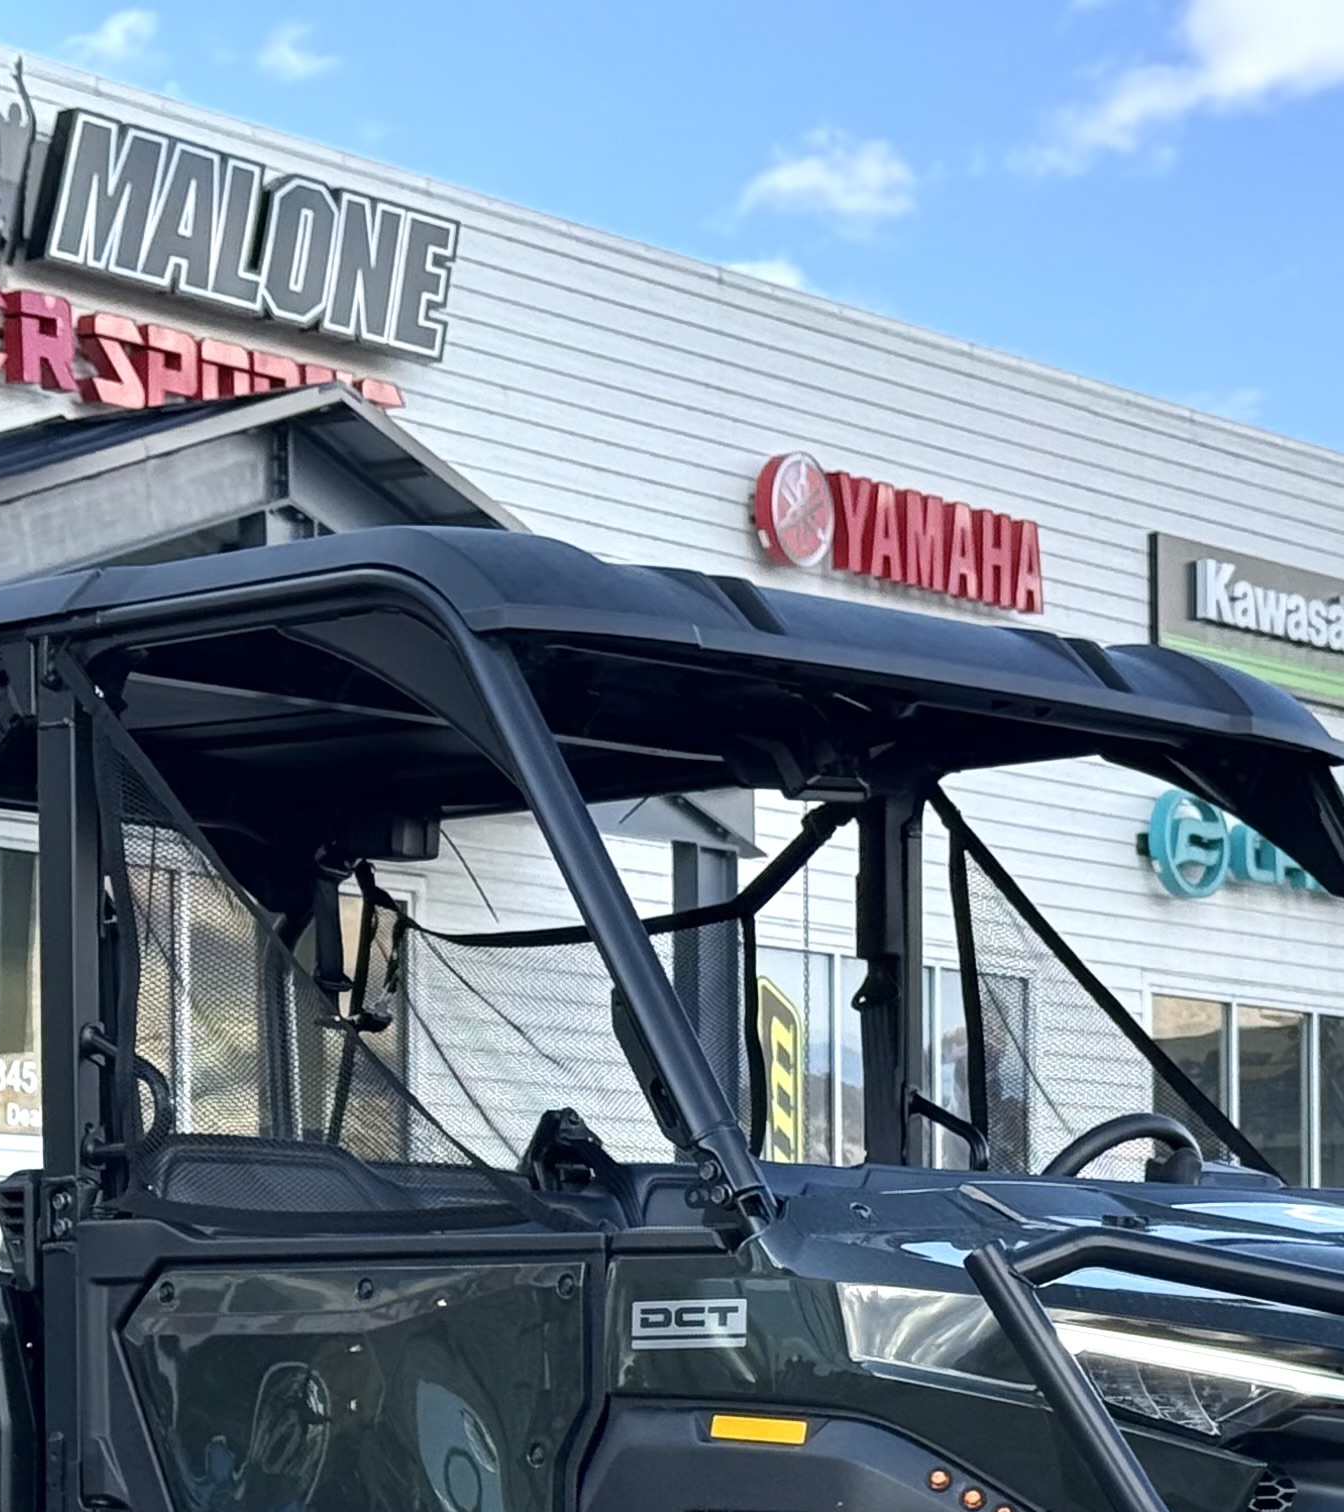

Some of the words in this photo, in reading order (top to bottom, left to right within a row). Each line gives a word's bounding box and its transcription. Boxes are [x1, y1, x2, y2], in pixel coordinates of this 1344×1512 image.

[46, 108, 460, 362] MALONE
[826, 470, 1044, 614] YAMAHA
[638, 1306, 739, 1330] DCT
